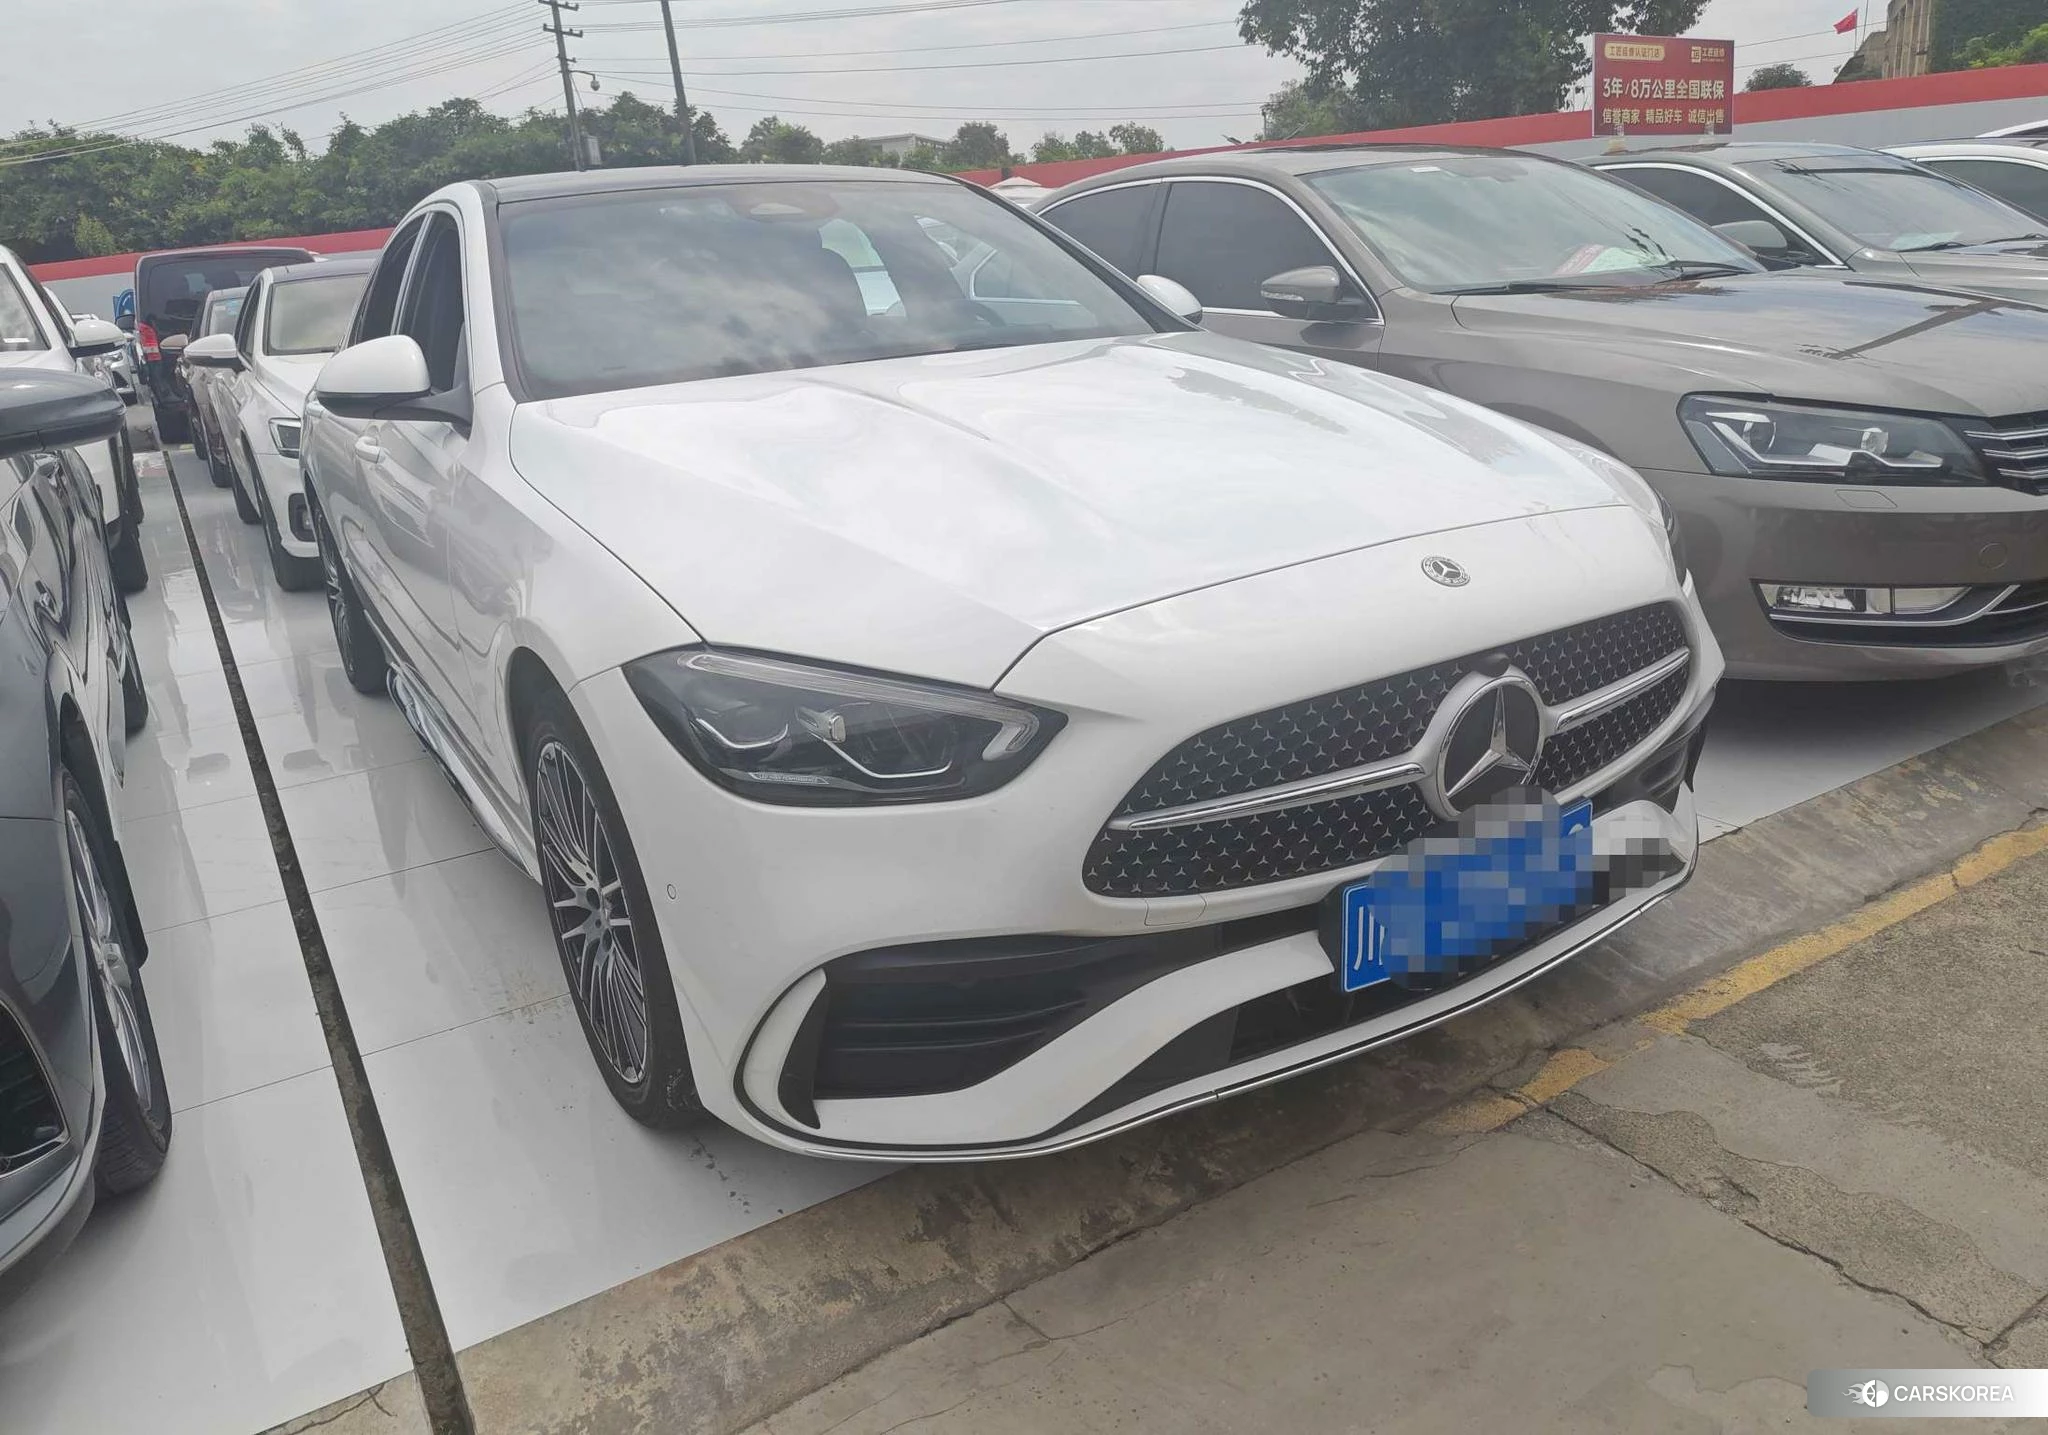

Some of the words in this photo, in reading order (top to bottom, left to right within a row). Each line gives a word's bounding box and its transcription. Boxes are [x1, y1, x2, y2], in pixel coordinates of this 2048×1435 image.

[1602, 108, 1641, 124] 信誉商家
[1645, 108, 1682, 124] 精品好车
[1688, 109, 1724, 124] 诚信出售
